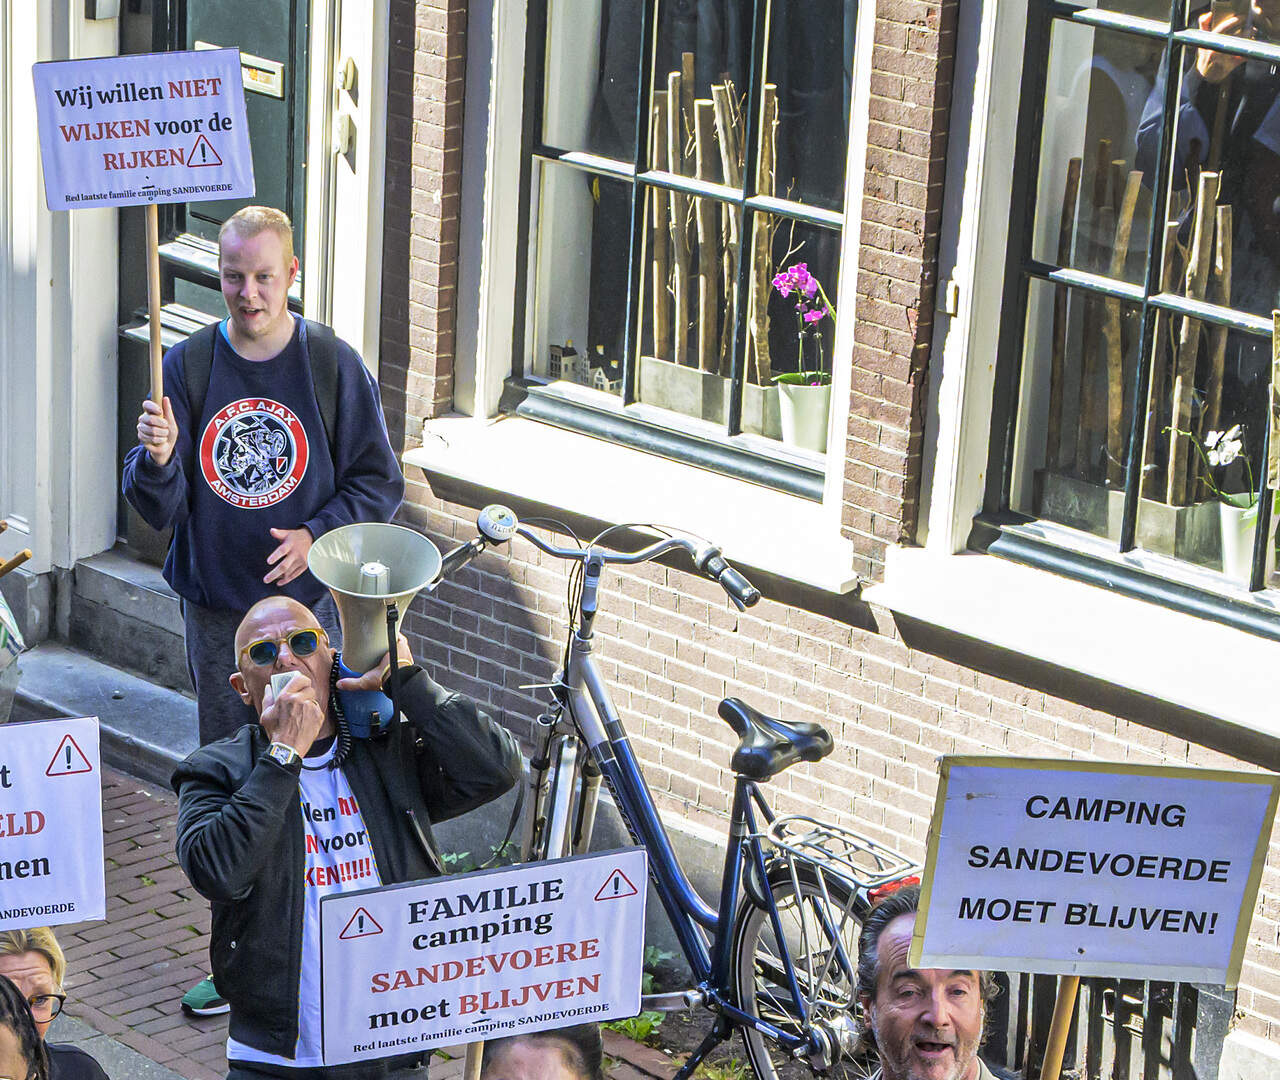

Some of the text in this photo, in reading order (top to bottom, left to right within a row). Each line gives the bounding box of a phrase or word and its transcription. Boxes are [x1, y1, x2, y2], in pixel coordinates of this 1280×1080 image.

[54, 78, 222, 109] Wij willen NIET
[59, 112, 233, 142] WIJKEN voor de
[103, 147, 186, 171] RIJKEN
[65, 183, 233, 203] Red laatste familie camping SANDEVOERDE
[256, 401, 296, 426] AJAX
[211, 476, 298, 507] AMSTERDAM
[1025, 795, 1187, 828] CAMPING
[320, 830, 366, 853] voor
[968, 845, 1231, 883] SANDEVOERDE
[408, 878, 564, 925] FAMILIE
[958, 897, 1219, 935] MOET BLIJVEN!
[412, 912, 554, 951] camping
[370, 938, 600, 994] SANDEVOERE
[369, 974, 601, 1029] moet BLIJVEN
[353, 1003, 609, 1053] Red laatste familie camping SANDEVOERDE
